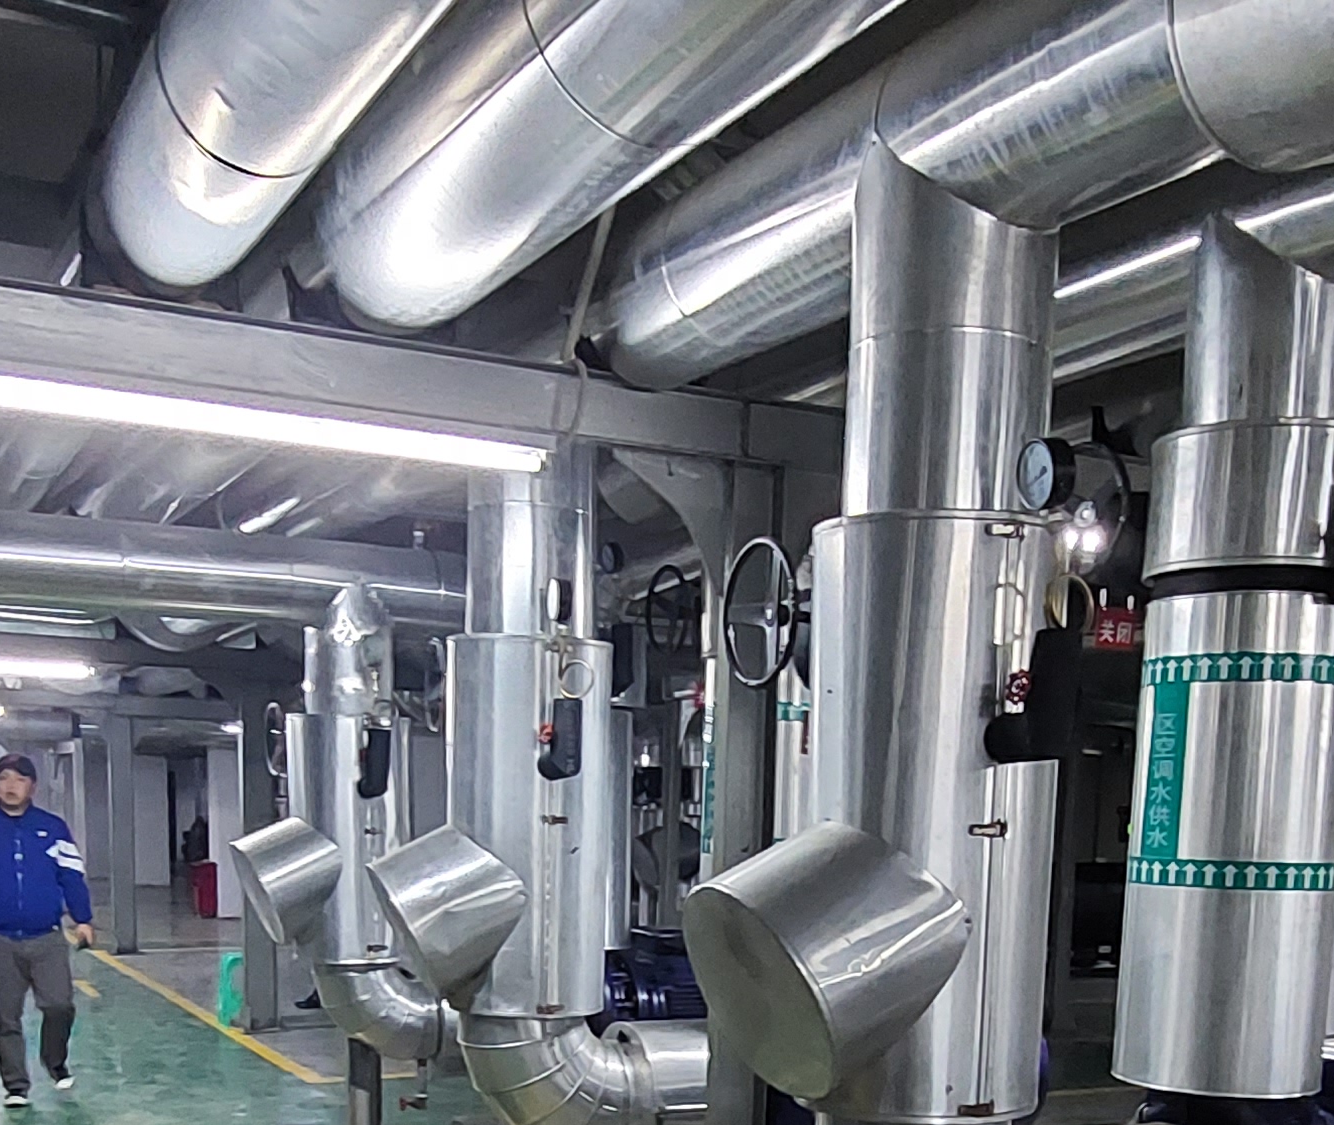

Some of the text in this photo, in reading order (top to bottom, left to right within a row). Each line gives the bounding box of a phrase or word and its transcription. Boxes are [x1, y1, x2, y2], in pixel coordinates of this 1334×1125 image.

[1099, 619, 1132, 644] 关闭
[1146, 713, 1177, 848] 区空调水供水
